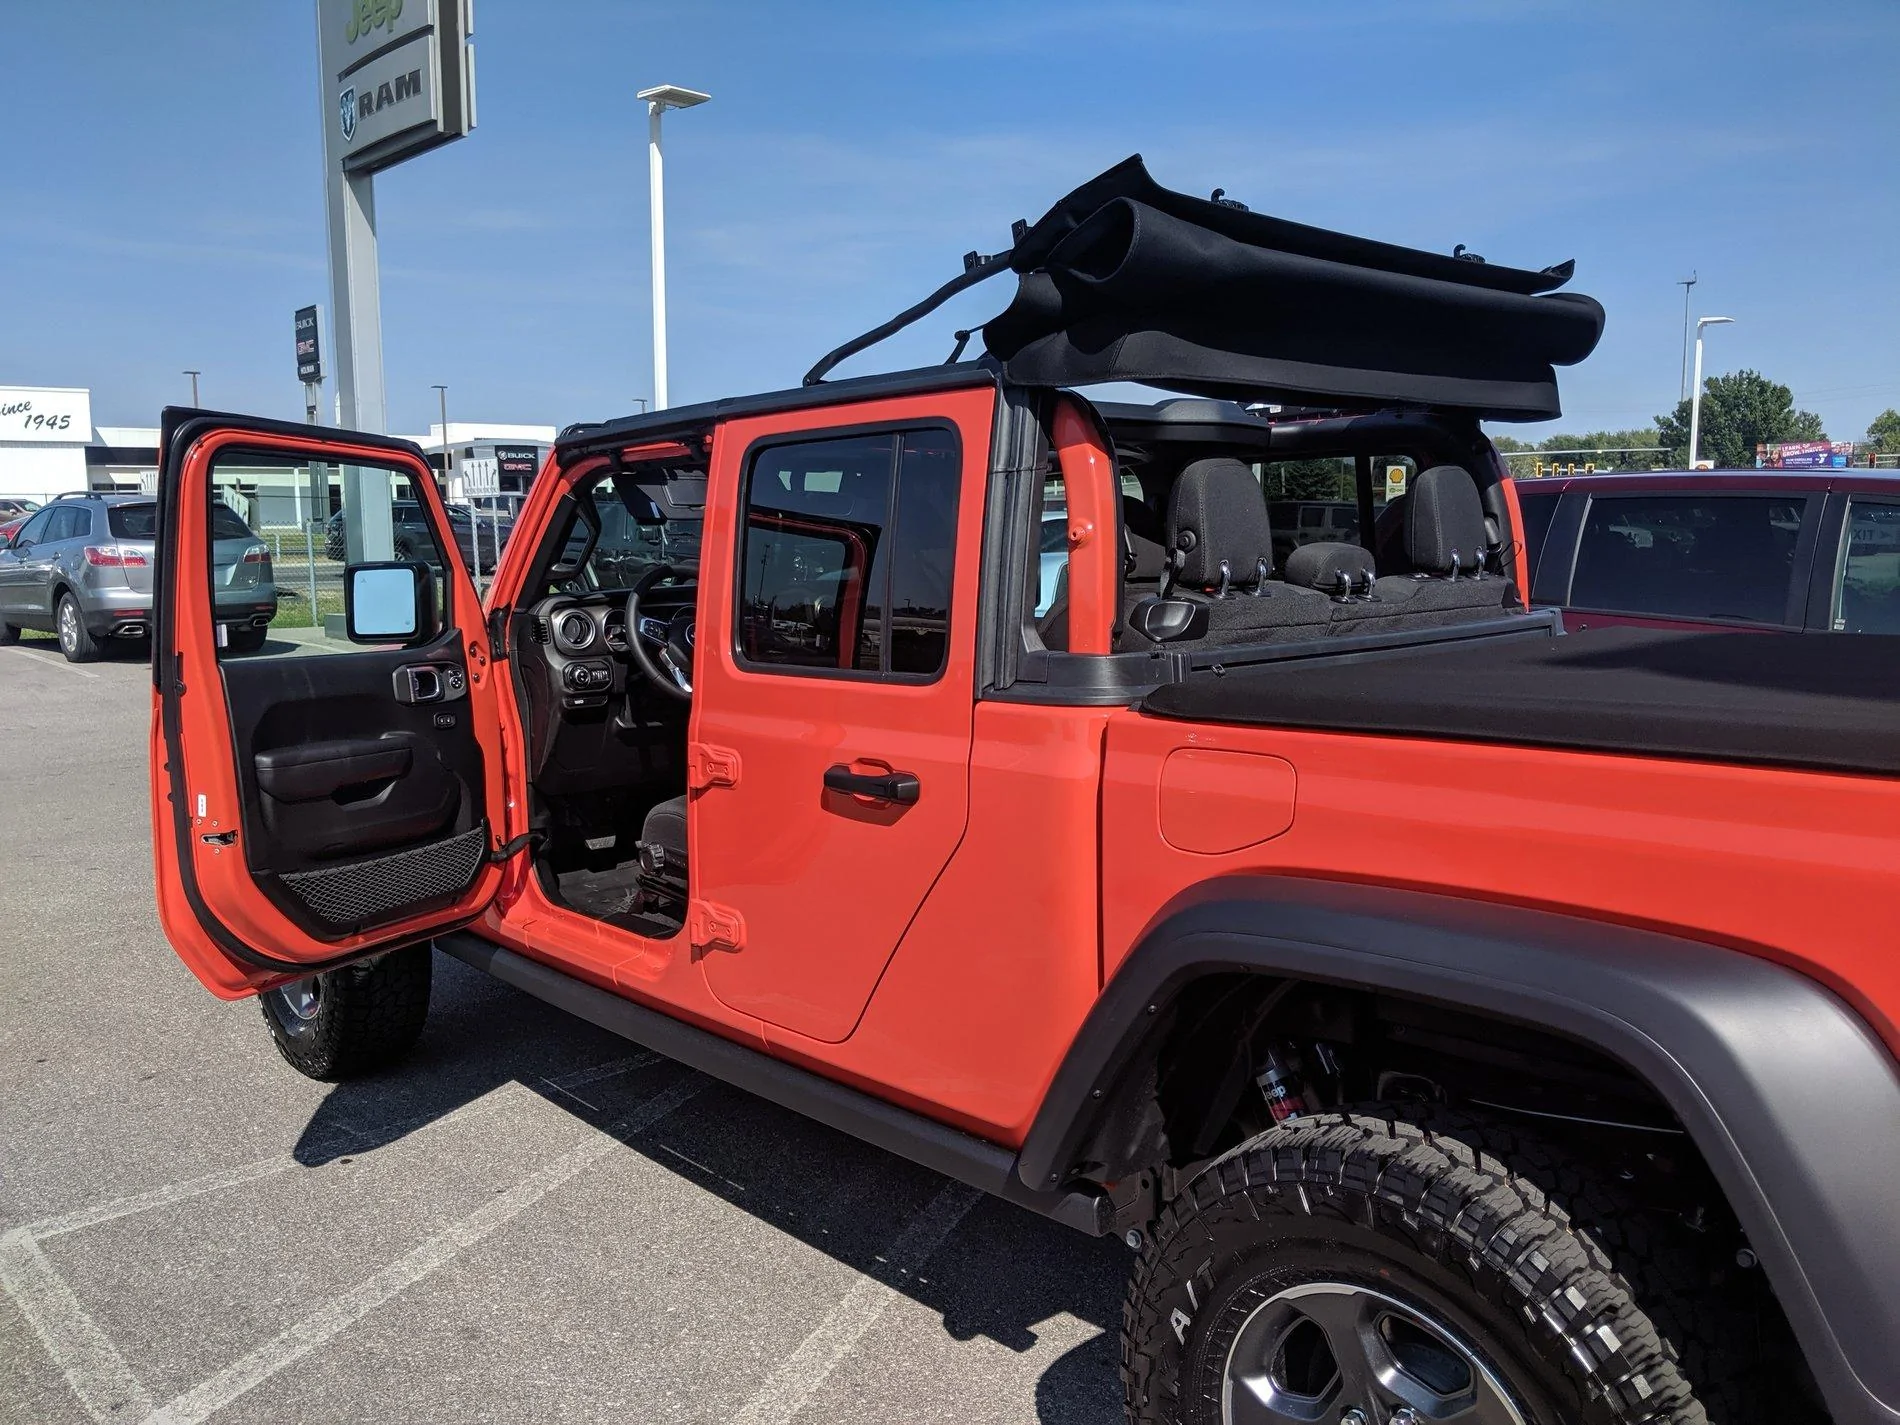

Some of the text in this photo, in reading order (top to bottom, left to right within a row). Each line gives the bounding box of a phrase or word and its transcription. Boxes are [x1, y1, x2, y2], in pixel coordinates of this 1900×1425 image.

[345, 0, 403, 44] Jeep
[358, 69, 422, 119] RAM
[0, 401, 32, 416] ince
[24, 414, 71, 430] 1945
[503, 463, 532, 471] GMC
[1852, 529, 1875, 541] XIT
[1265, 1085, 1287, 1100] eep
